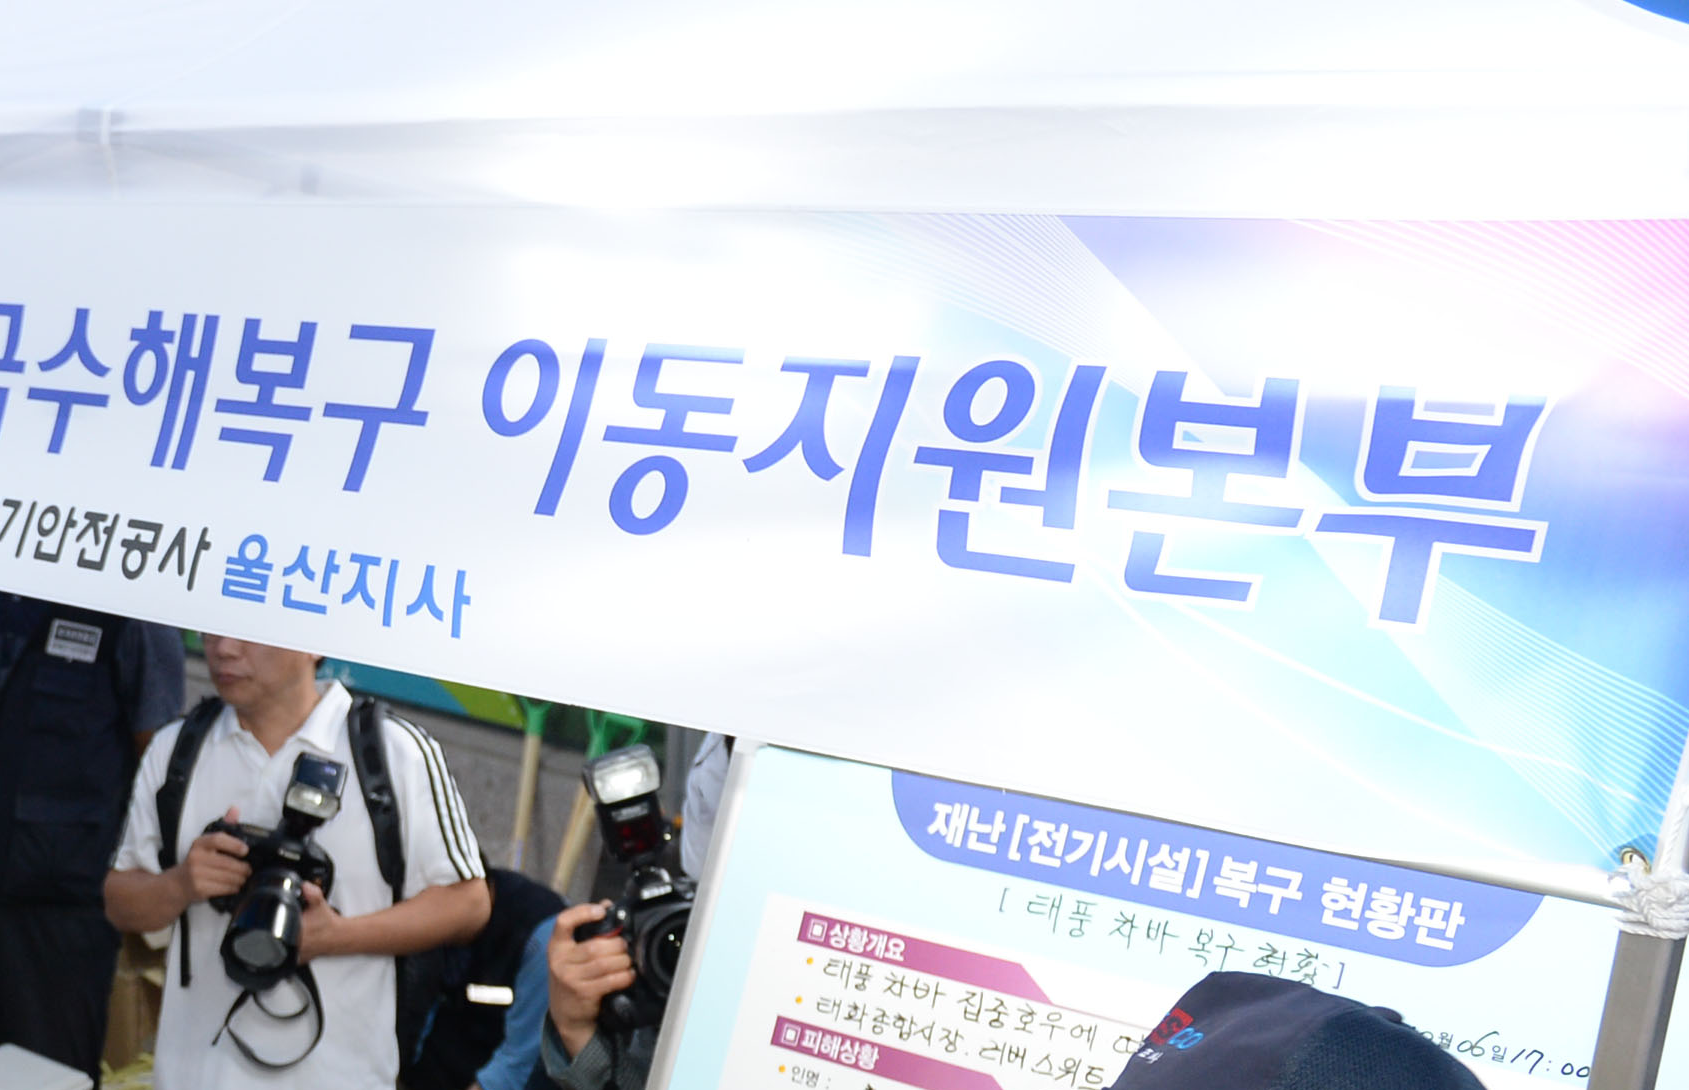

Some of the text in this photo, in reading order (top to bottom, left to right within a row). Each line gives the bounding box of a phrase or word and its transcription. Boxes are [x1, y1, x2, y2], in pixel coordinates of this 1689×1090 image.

[482, 337, 1545, 625] 이동지원본부
[221, 533, 471, 639] 울산지사
[829, 923, 906, 962] 상황개요
[1026, 894, 1098, 938] 태풍
[1108, 911, 1180, 955] 차바
[1187, 929, 1245, 971] 복구
[1213, 856, 1303, 915] 복구
[1321, 877, 1465, 951] 현황판
[822, 957, 873, 992] 태풍
[956, 990, 1098, 1050] 집중호우에
[790, 1065, 821, 1089] 인명
[801, 1029, 880, 1071] 피해상황
